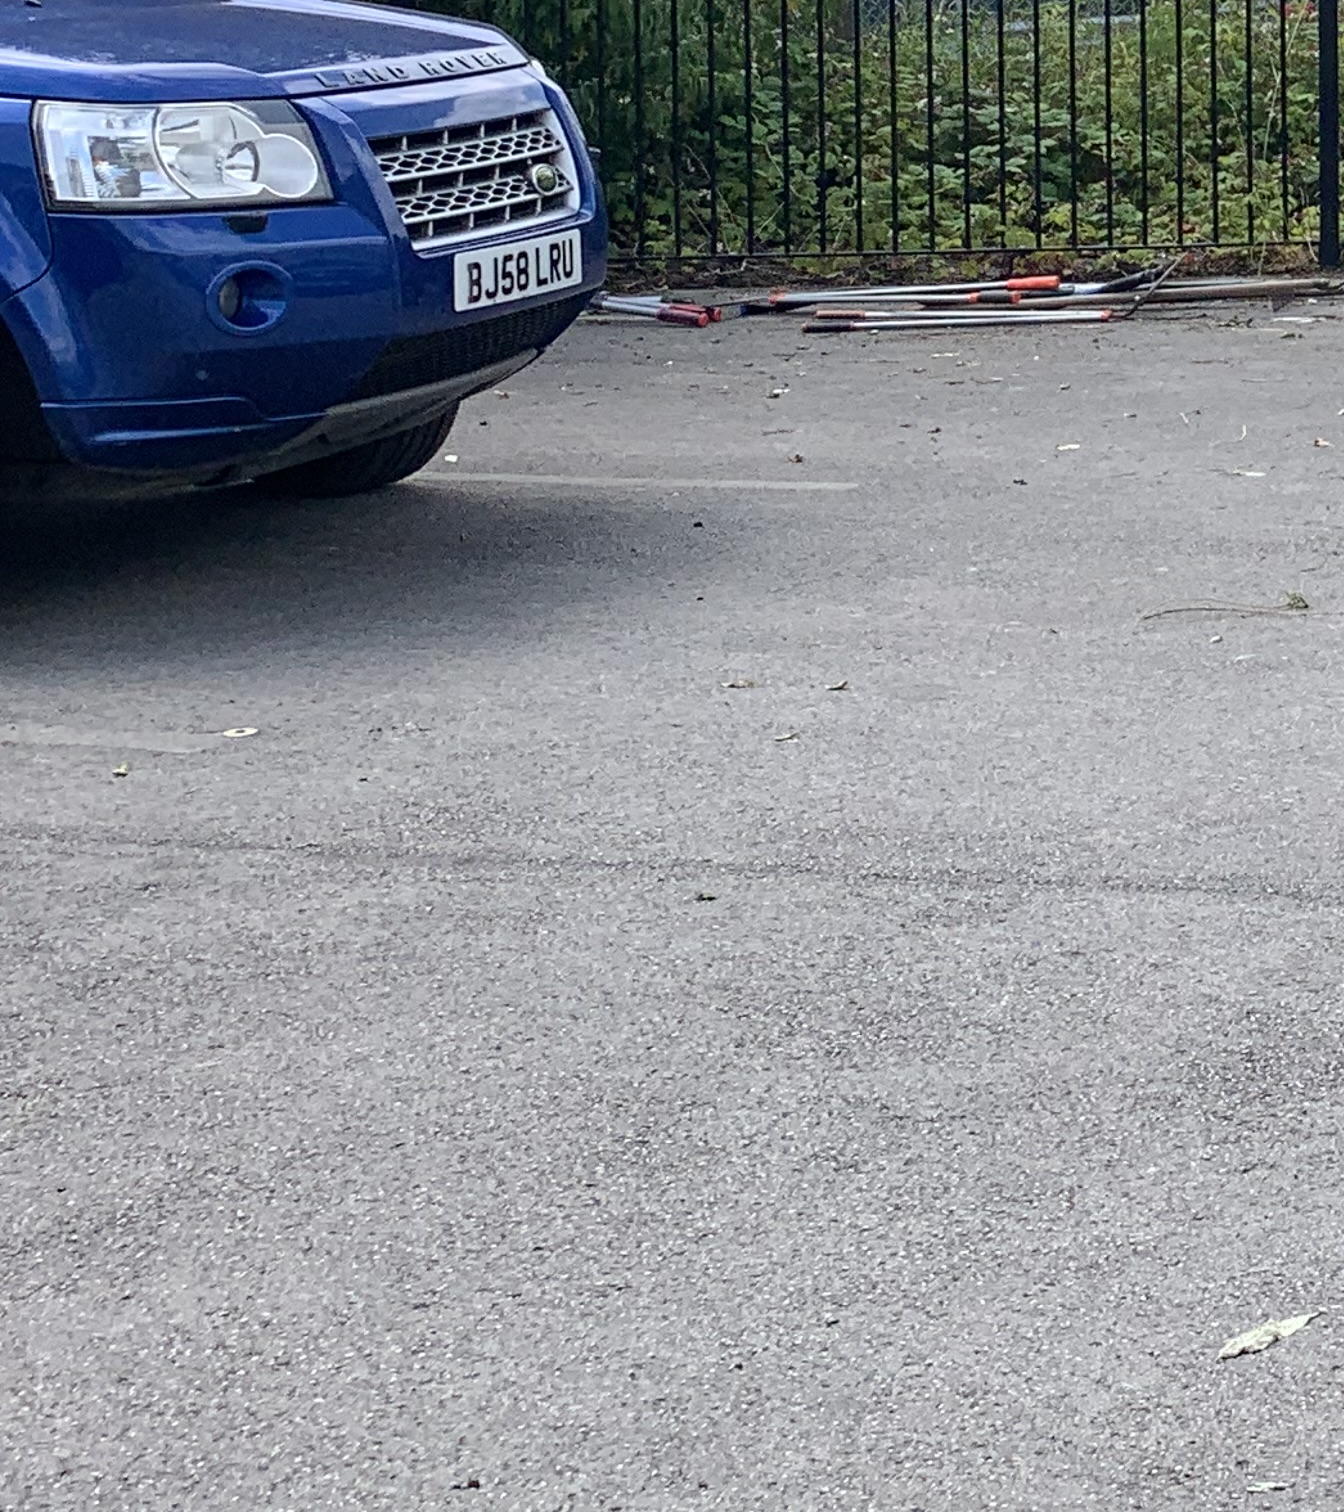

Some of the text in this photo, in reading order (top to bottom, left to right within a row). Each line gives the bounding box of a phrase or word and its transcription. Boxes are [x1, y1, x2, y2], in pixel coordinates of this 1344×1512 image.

[314, 51, 508, 88] LAND ROVER
[466, 238, 574, 305] BJ58 LRU
